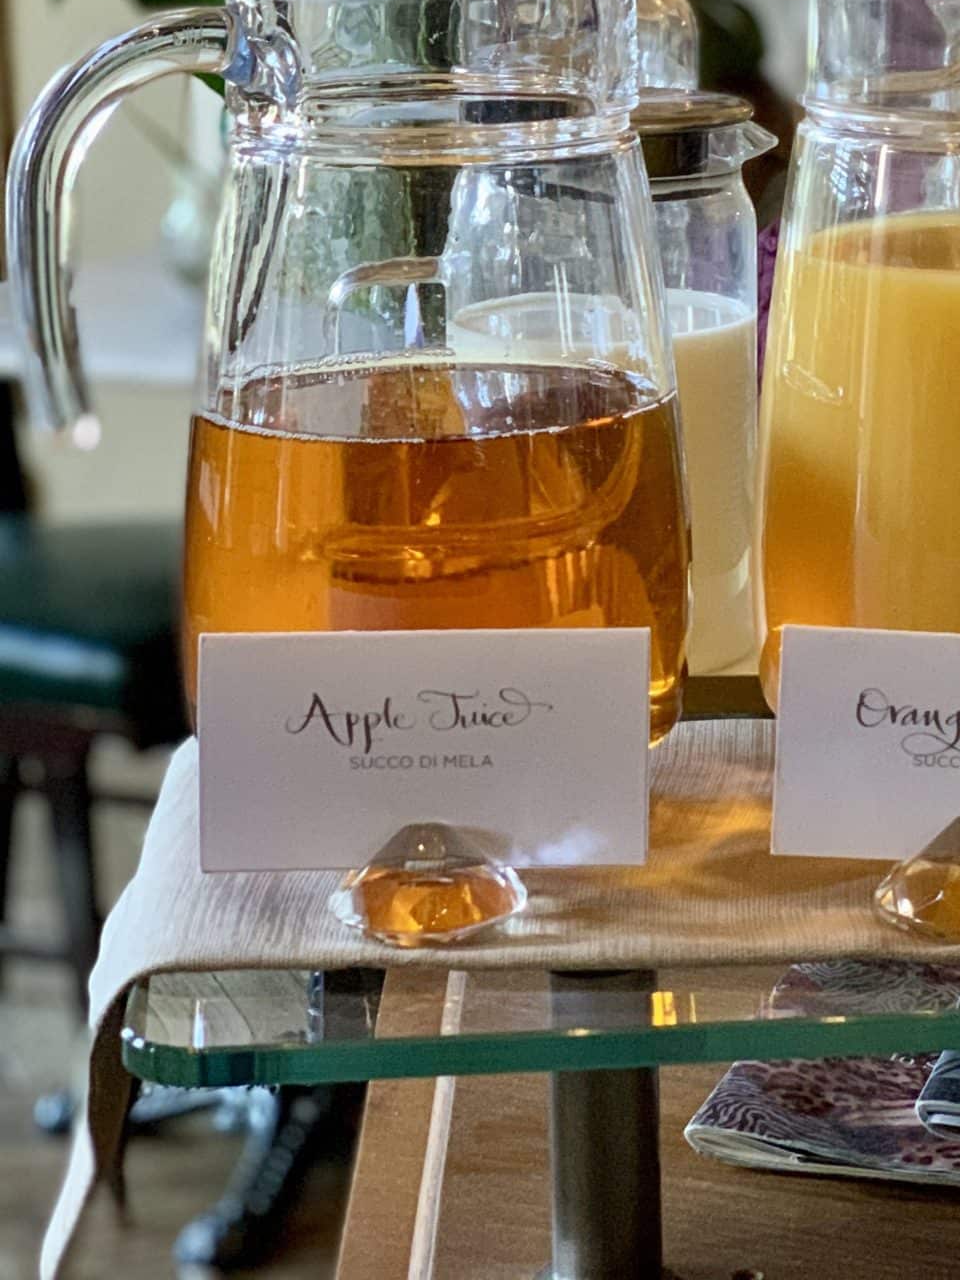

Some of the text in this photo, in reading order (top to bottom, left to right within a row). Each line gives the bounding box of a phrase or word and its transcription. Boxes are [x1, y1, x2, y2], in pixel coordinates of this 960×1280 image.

[286, 687, 554, 754] Apple Juice
[349, 754, 494, 770] SUCCO DI MELA
